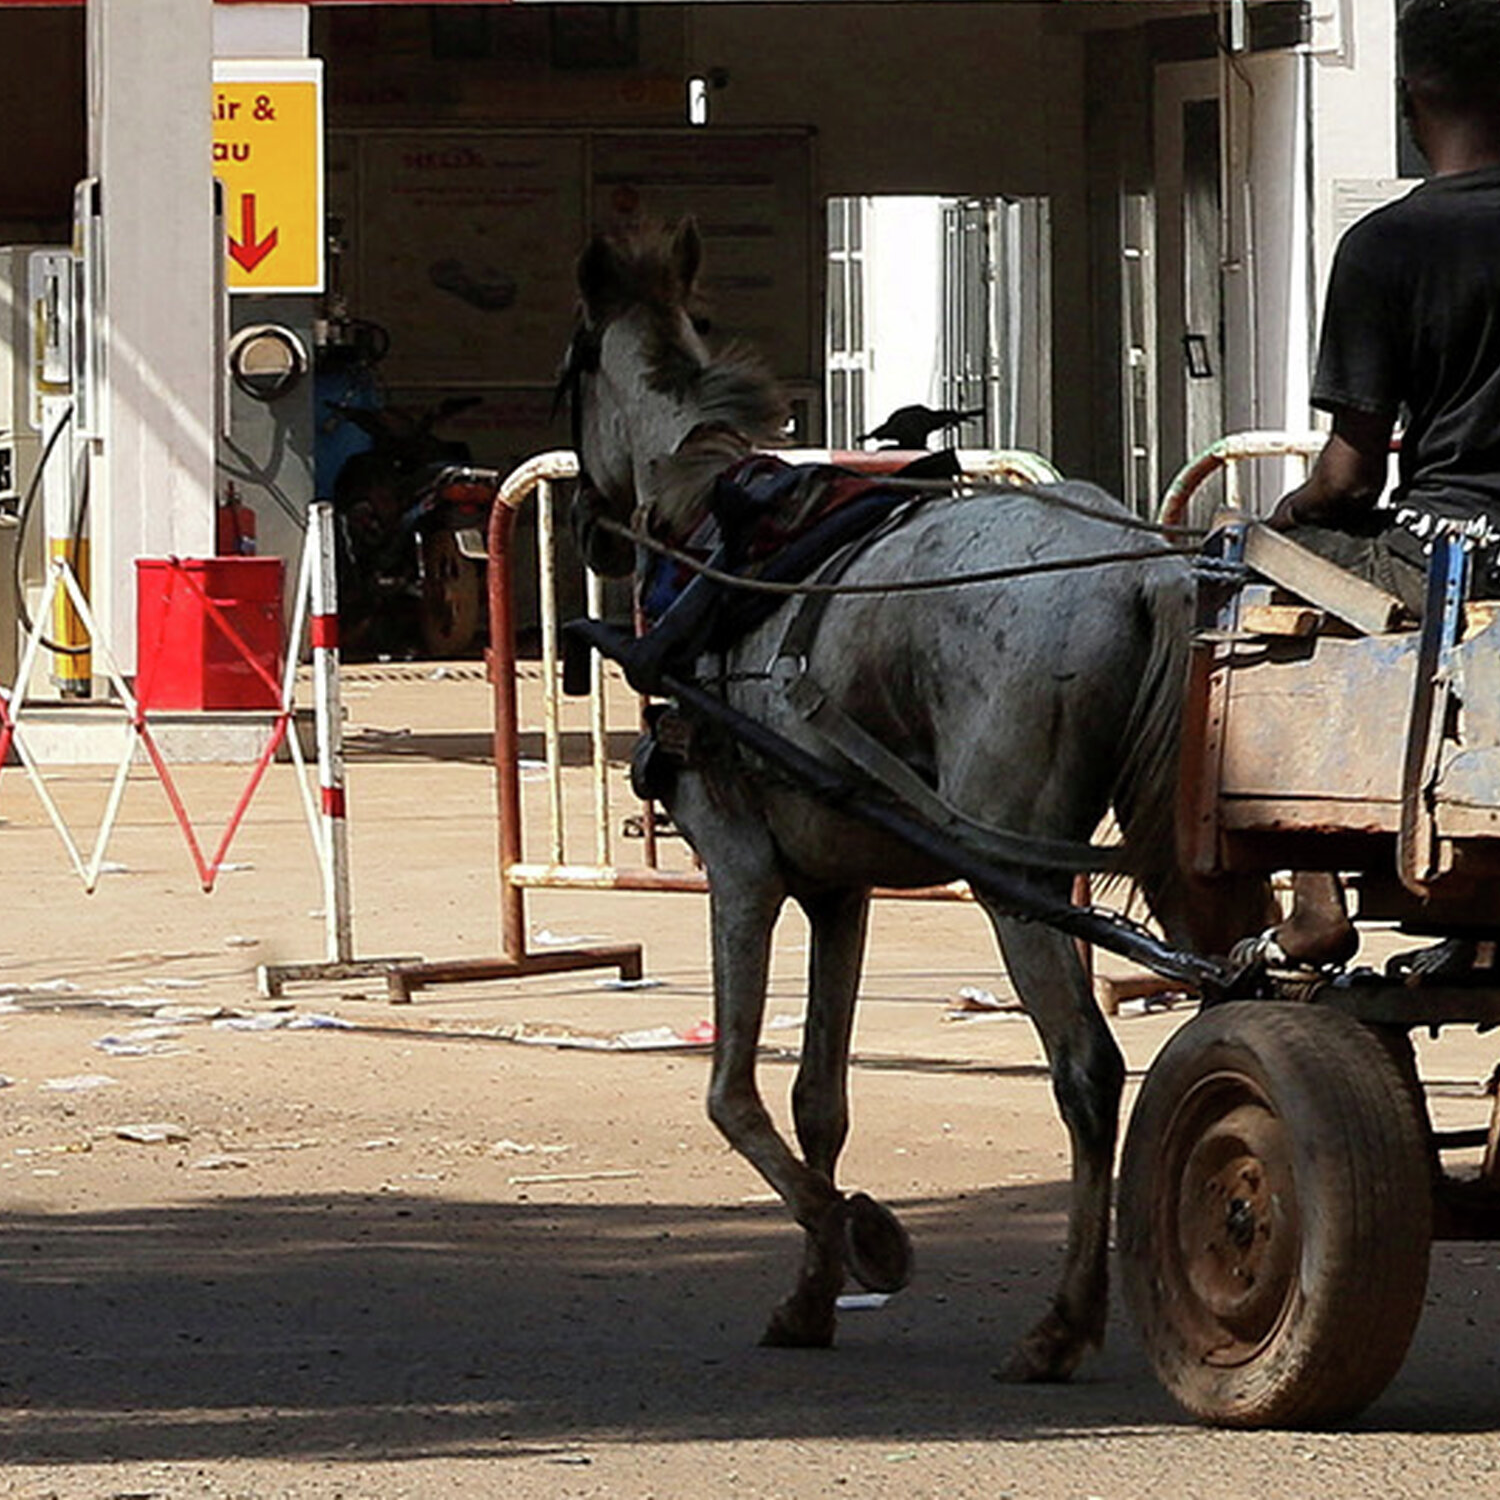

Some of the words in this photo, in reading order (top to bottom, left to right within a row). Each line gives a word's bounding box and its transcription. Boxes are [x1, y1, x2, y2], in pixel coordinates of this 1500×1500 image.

[213, 94, 242, 120] ir
[253, 95, 276, 121] &
[213, 143, 250, 162] au
